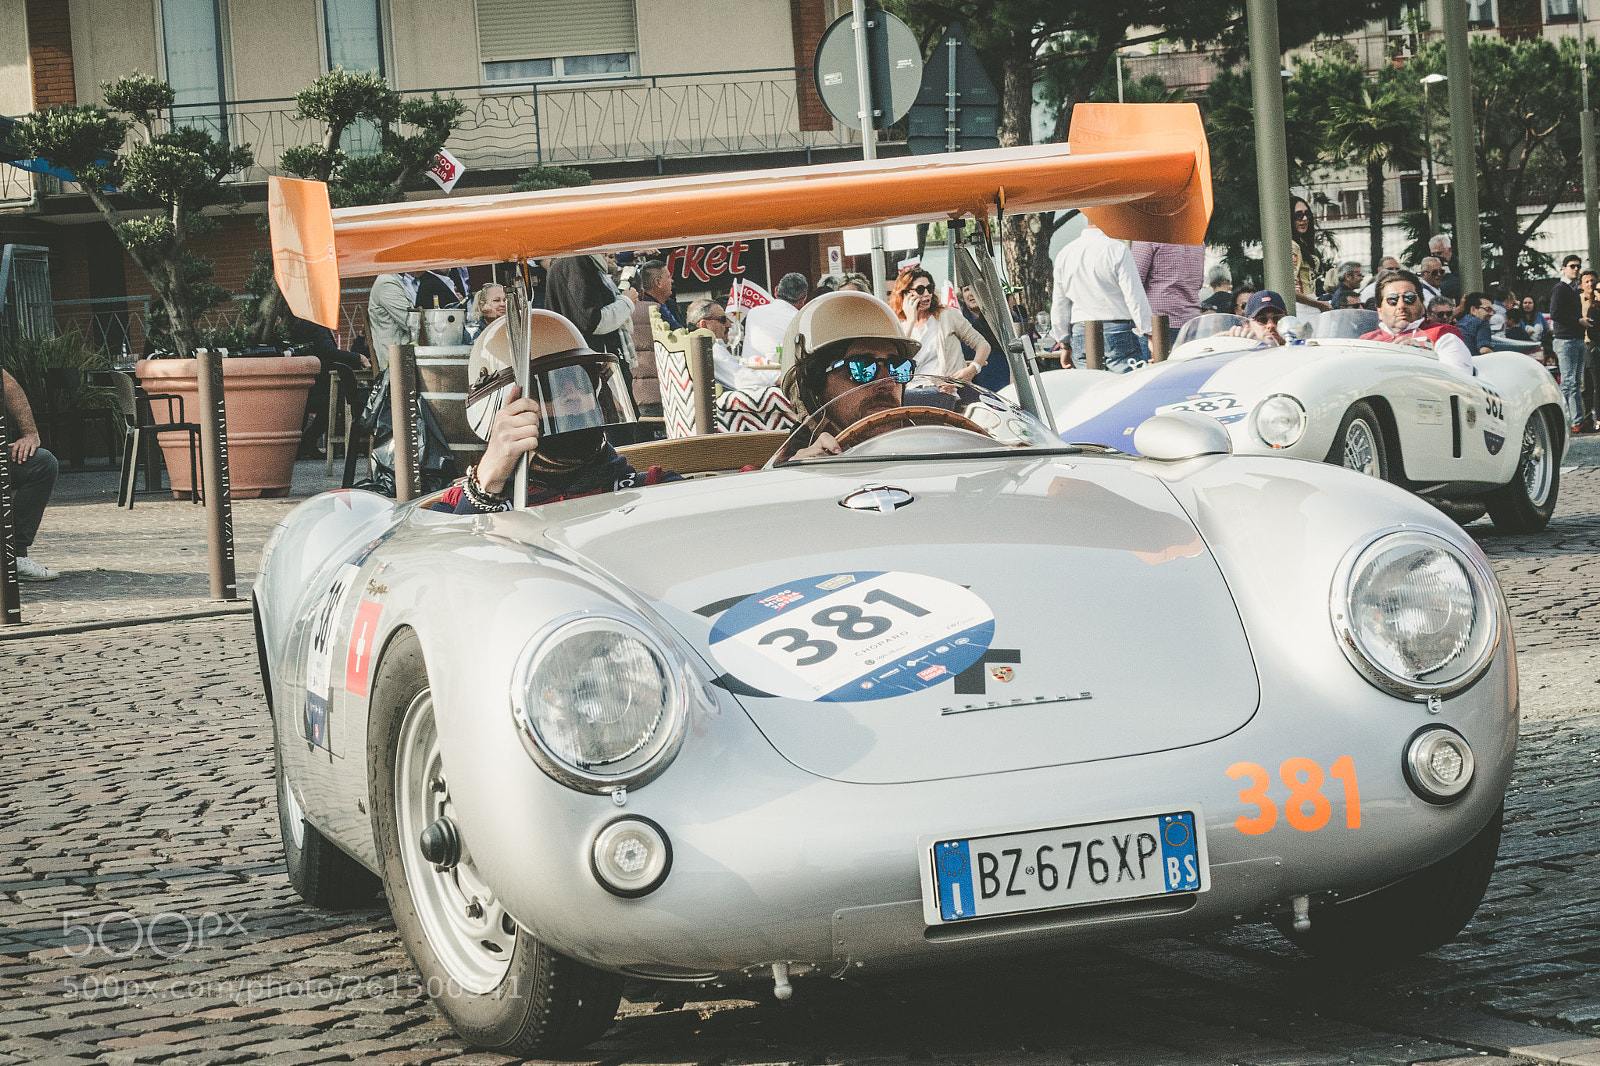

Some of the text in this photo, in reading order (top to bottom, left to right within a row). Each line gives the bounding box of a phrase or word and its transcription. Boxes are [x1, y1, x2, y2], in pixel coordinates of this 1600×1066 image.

[666, 240, 749, 282] rket
[743, 288, 766, 305] 1000
[5, 533, 16, 583] PIAZZA
[758, 588, 931, 666] 381
[854, 630, 909, 657] CHOPARD
[1225, 755, 1361, 835] 381
[1166, 854, 1197, 885] BS
